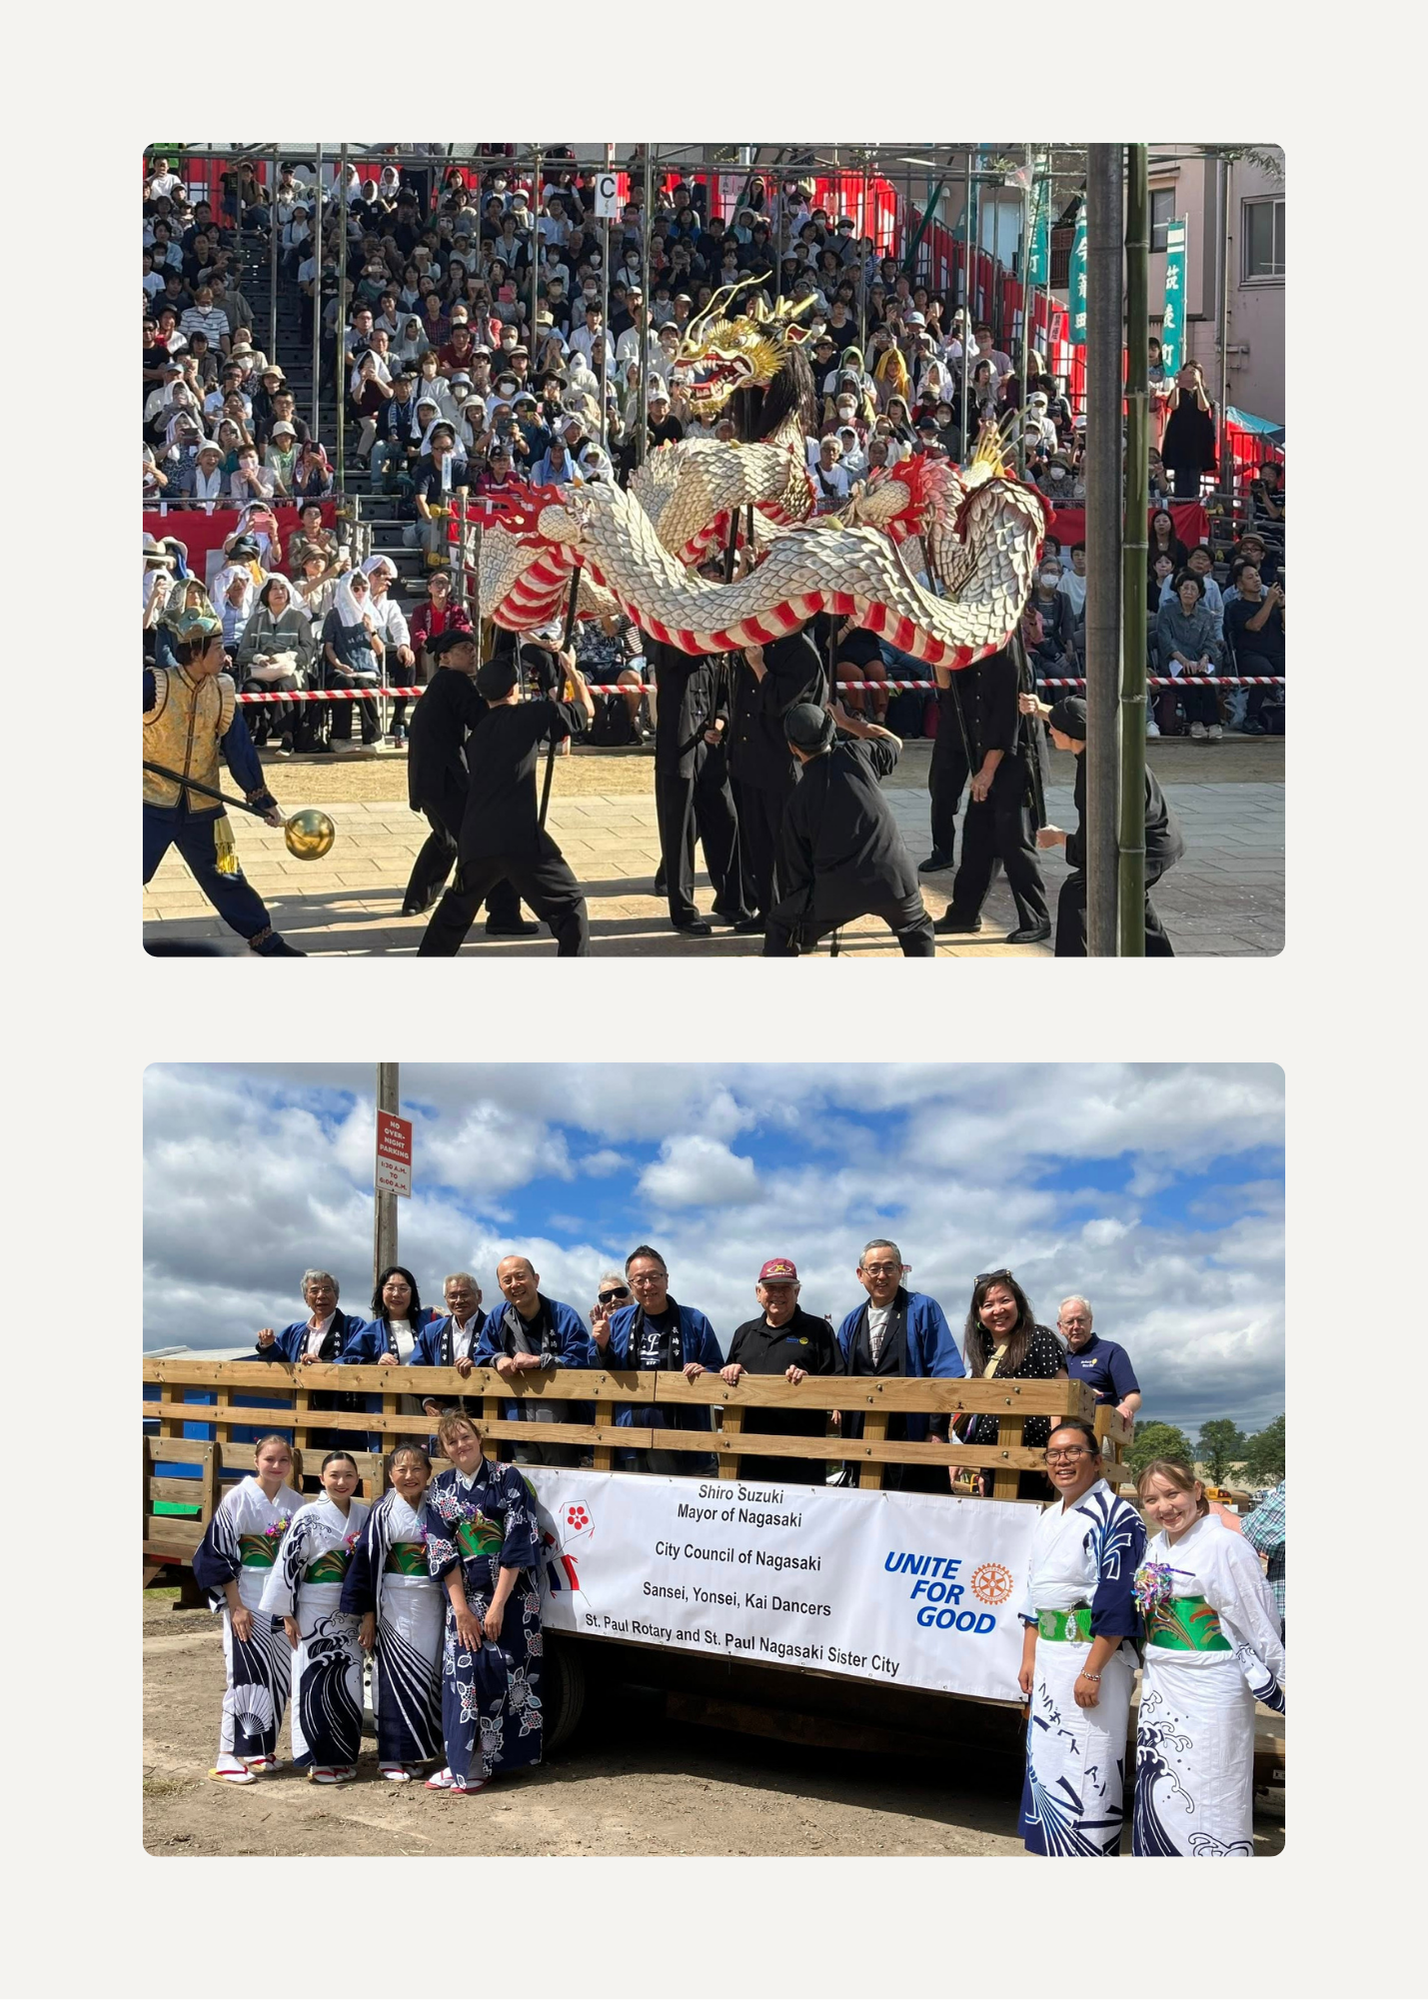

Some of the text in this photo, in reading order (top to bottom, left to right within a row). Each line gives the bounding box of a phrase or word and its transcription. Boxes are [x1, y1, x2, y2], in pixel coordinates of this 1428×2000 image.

[600, 177, 616, 199] C
[384, 1127, 406, 1140] OVER-
[390, 1121, 400, 1130] NO
[379, 1143, 409, 1159] PARKING
[384, 1136, 405, 1149] NIGHT
[389, 1171, 398, 1180] TO
[698, 1484, 784, 1504] Shiro Suzuki
[677, 1503, 802, 1528] Mayor of Nagasaki
[655, 1541, 821, 1571] City Council of Nagasaki
[884, 1551, 963, 1580] UNITE
[643, 1581, 831, 1617] Sansei, Yonsei, Kai Dancers
[909, 1579, 965, 1606] FOR
[916, 1605, 997, 1634] GOOD
[585, 1613, 900, 1678] St. Paul Rotary and St. Paul Nagasaki Sister City
